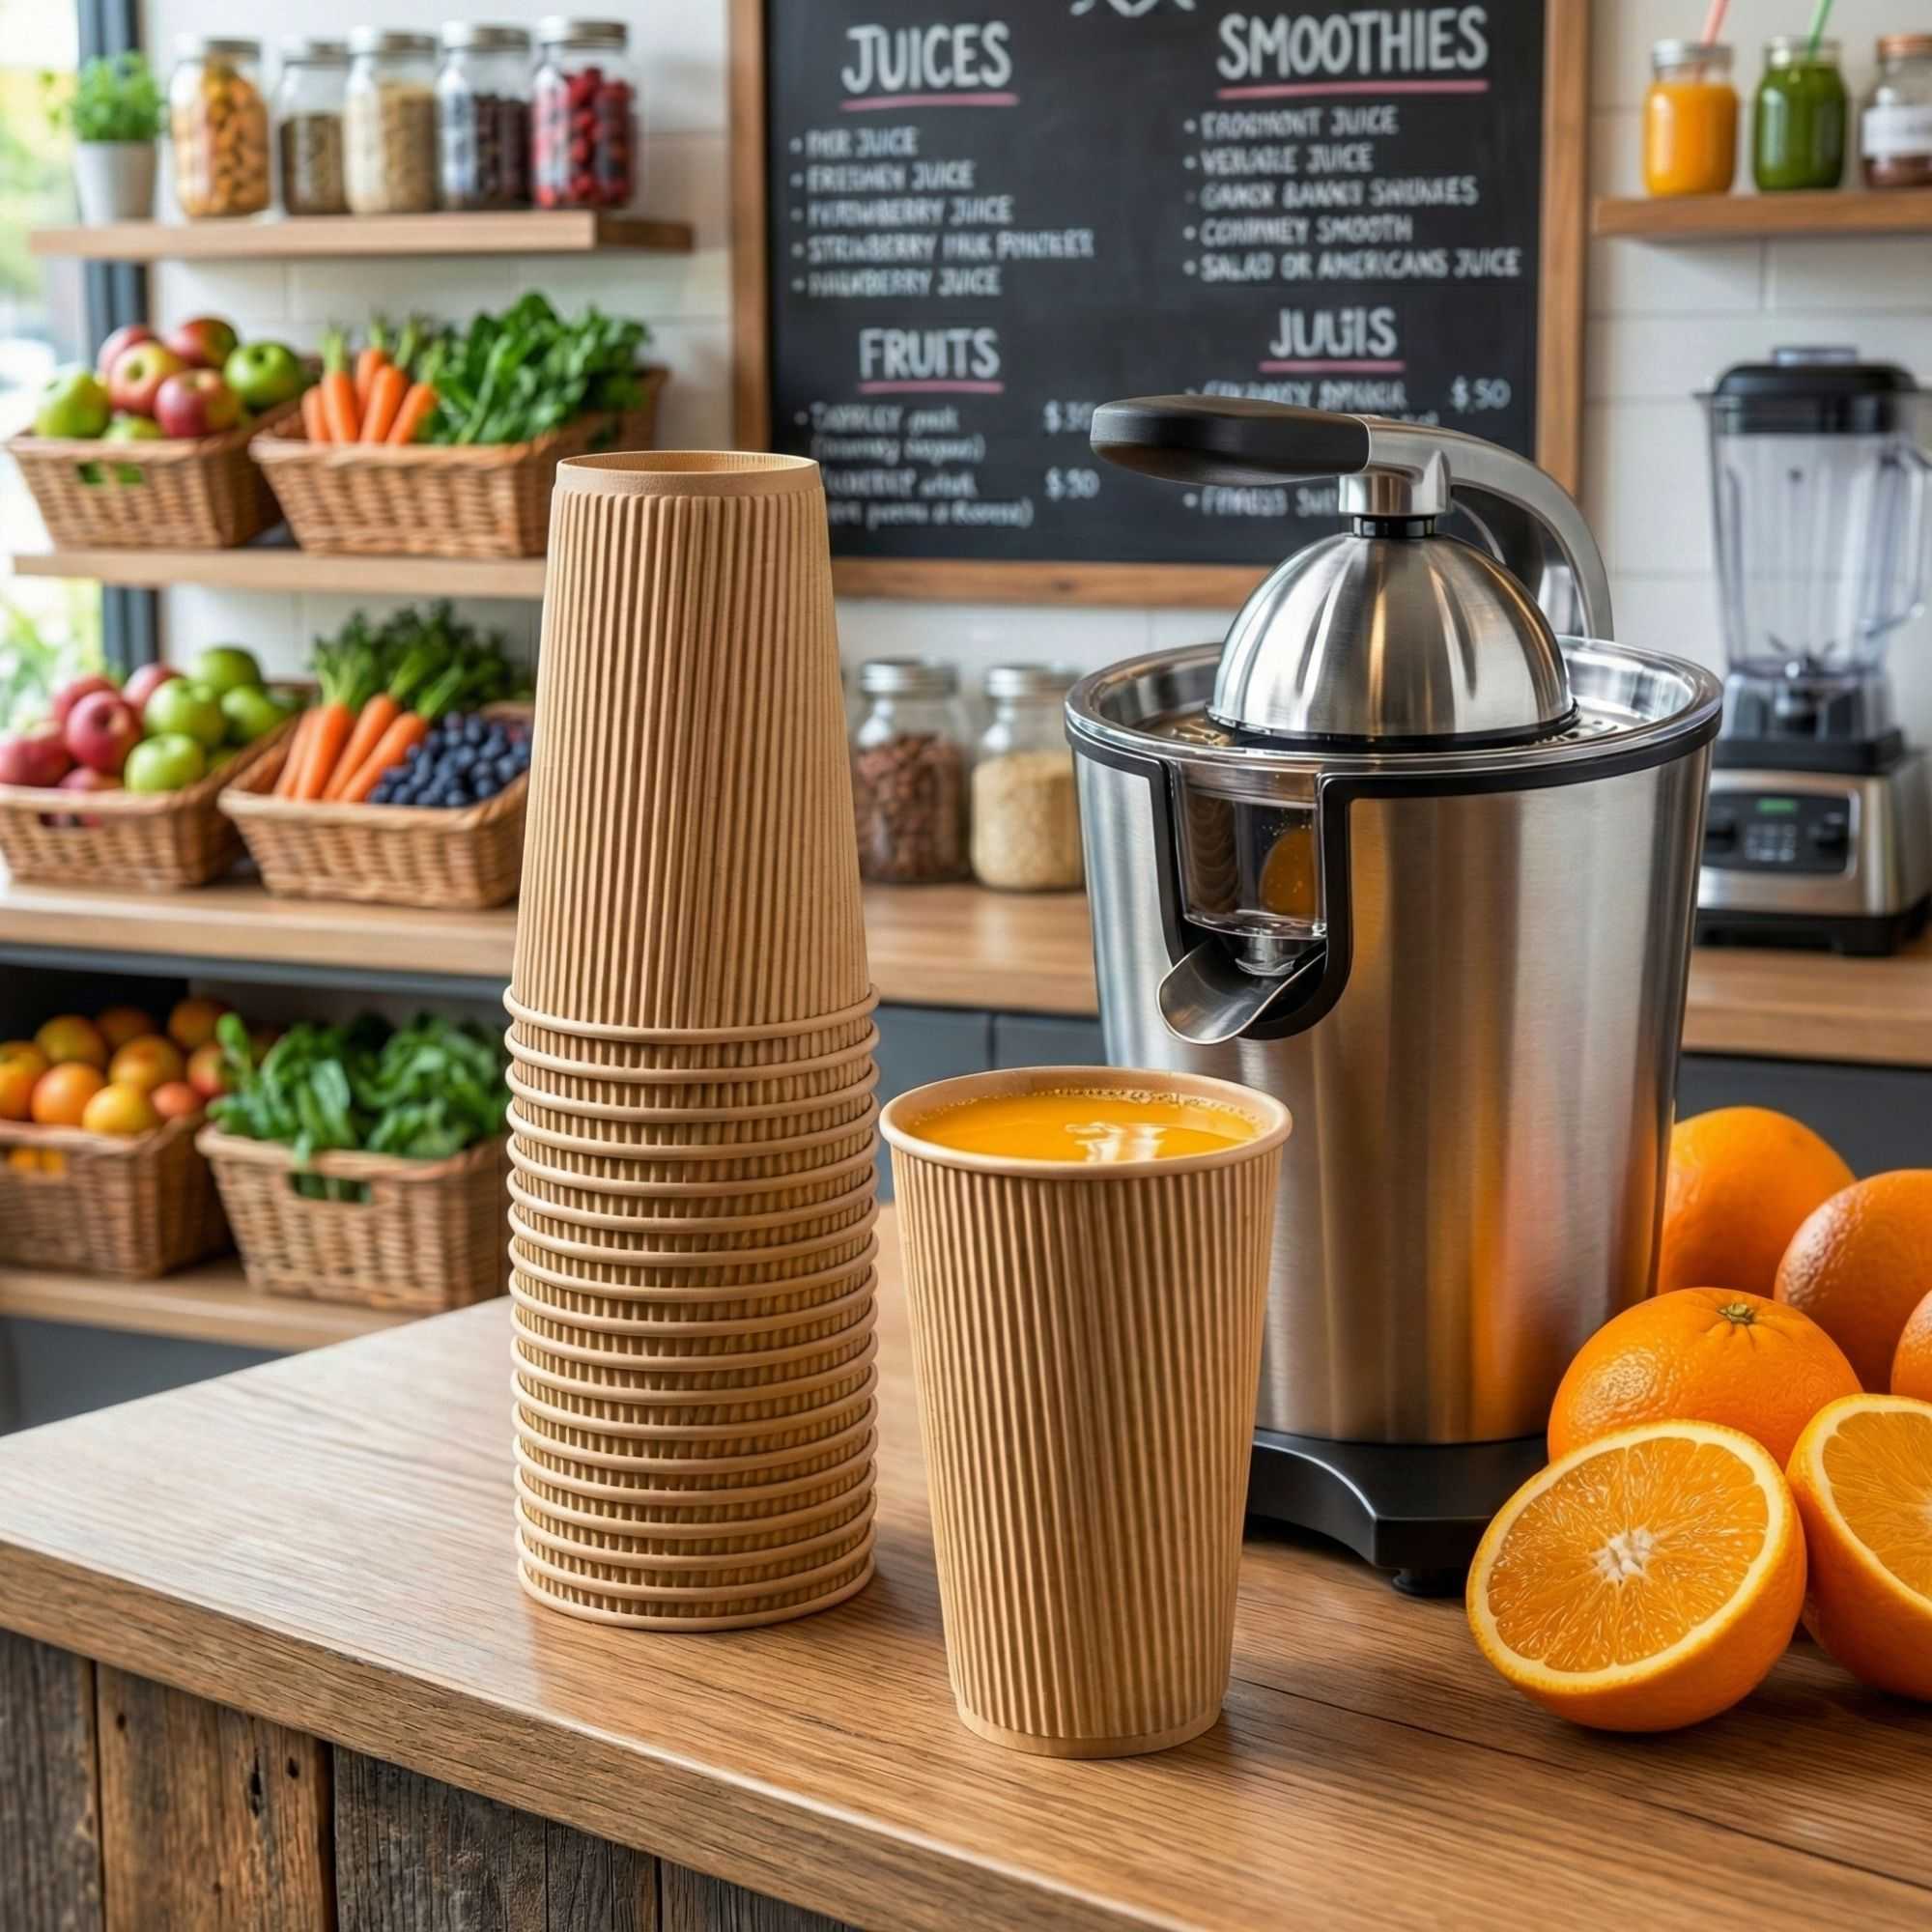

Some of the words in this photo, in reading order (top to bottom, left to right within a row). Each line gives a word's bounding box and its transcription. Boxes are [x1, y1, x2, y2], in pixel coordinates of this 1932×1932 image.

[841, 20, 1011, 94] JUICES
[1216, 6, 1489, 79] SMOOTHIES
[1330, 105, 1399, 136] JUICE
[855, 126, 919, 157] JUICE
[1306, 143, 1375, 174] JUICE
[1453, 246, 1522, 277] JUICE
[938, 266, 1002, 297] JUICE
[859, 327, 1001, 379] FRUITS
